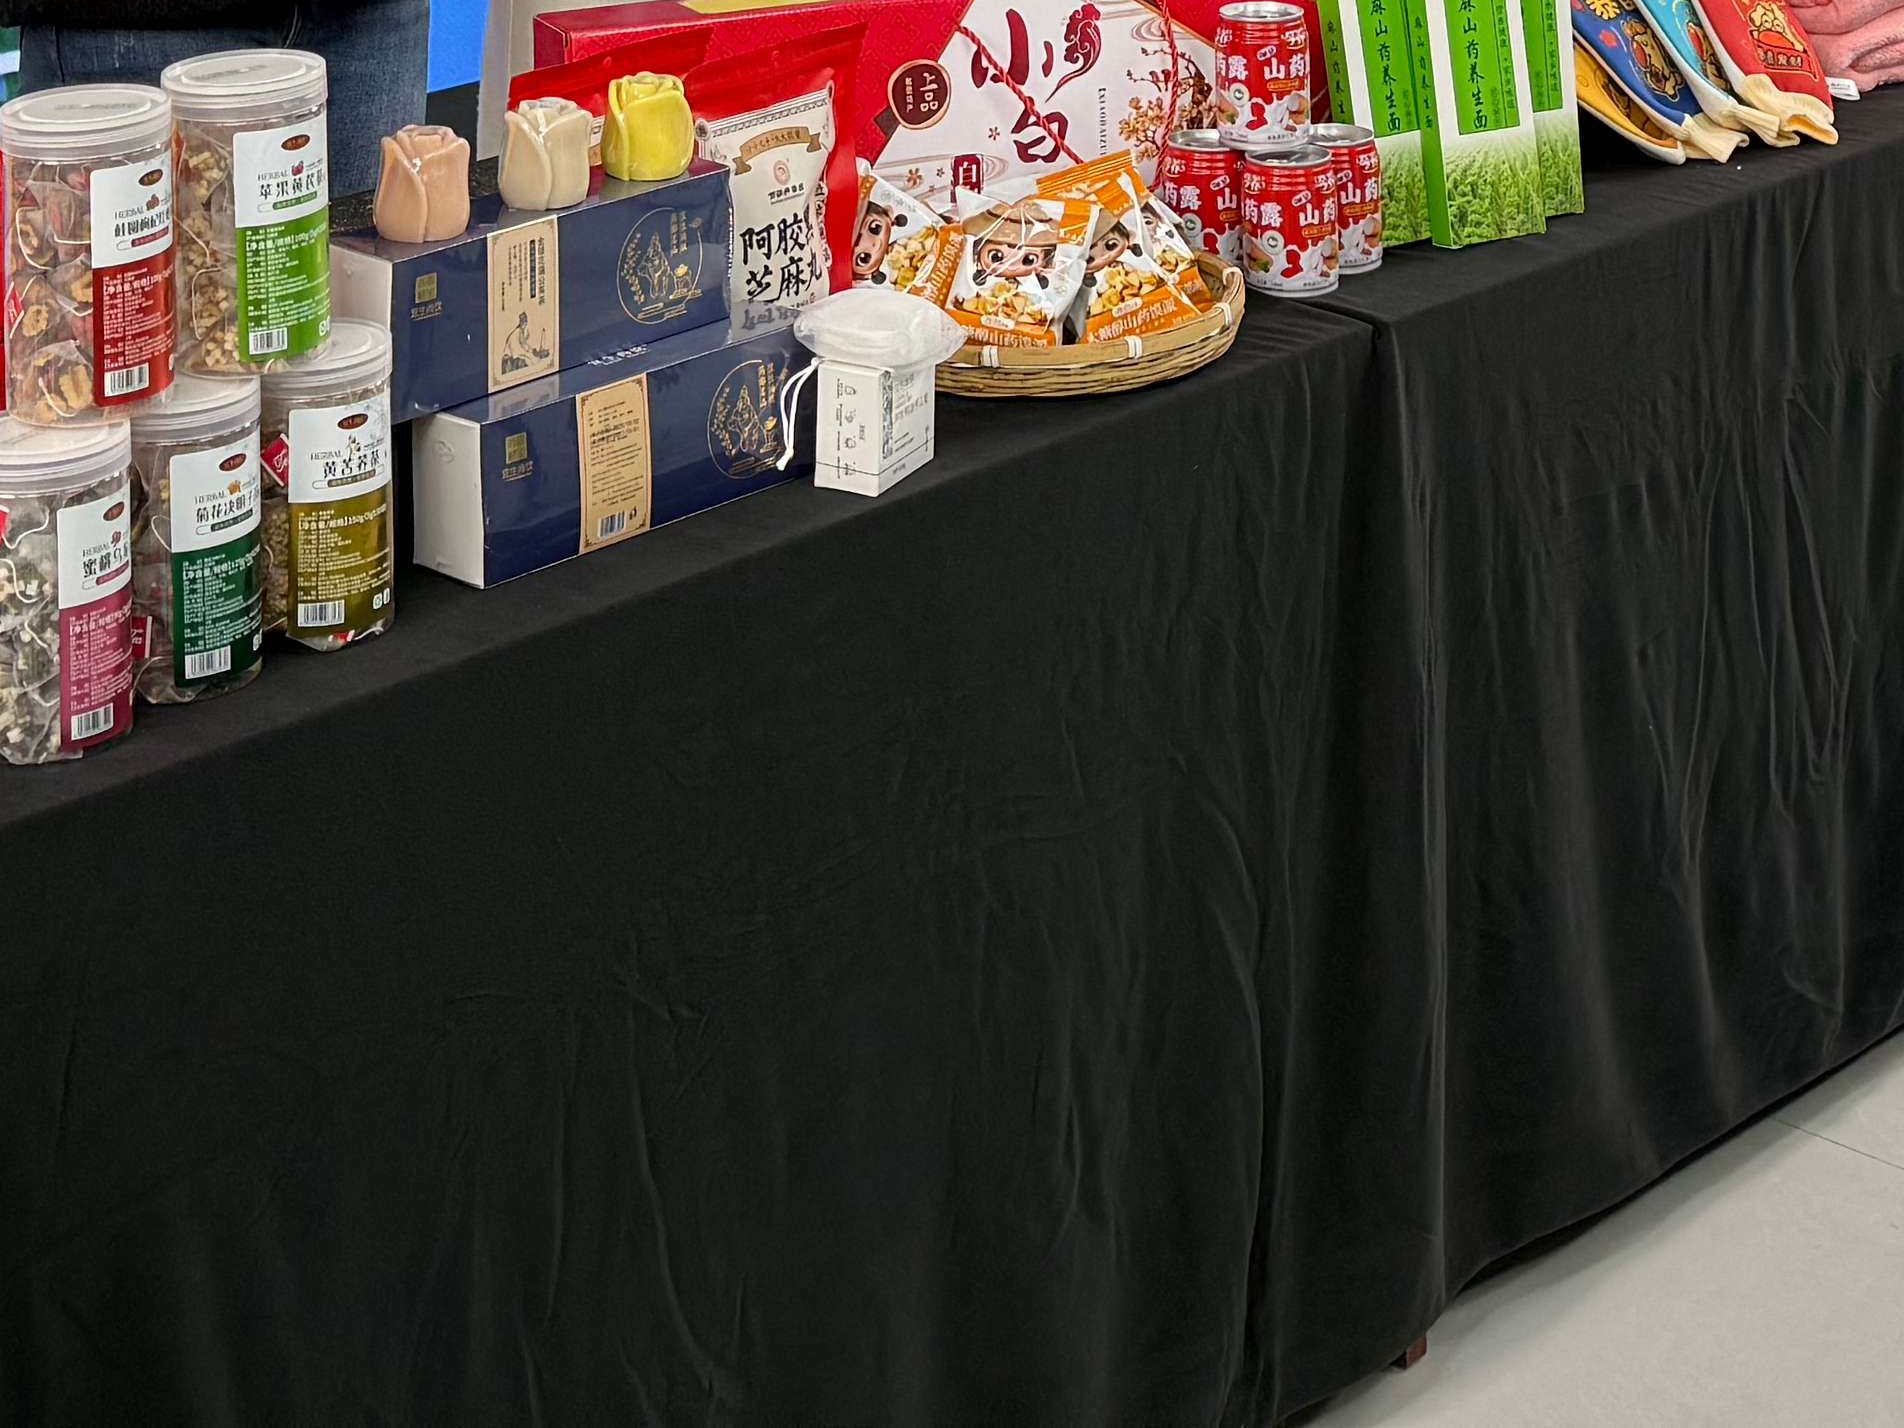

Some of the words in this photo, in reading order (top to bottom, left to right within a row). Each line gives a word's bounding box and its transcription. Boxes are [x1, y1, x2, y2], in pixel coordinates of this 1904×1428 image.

[1263, 55, 1309, 80] 山药
[919, 72, 939, 113] 上品
[739, 210, 807, 266] 阿胶
[746, 250, 824, 304] 芝麻丸
